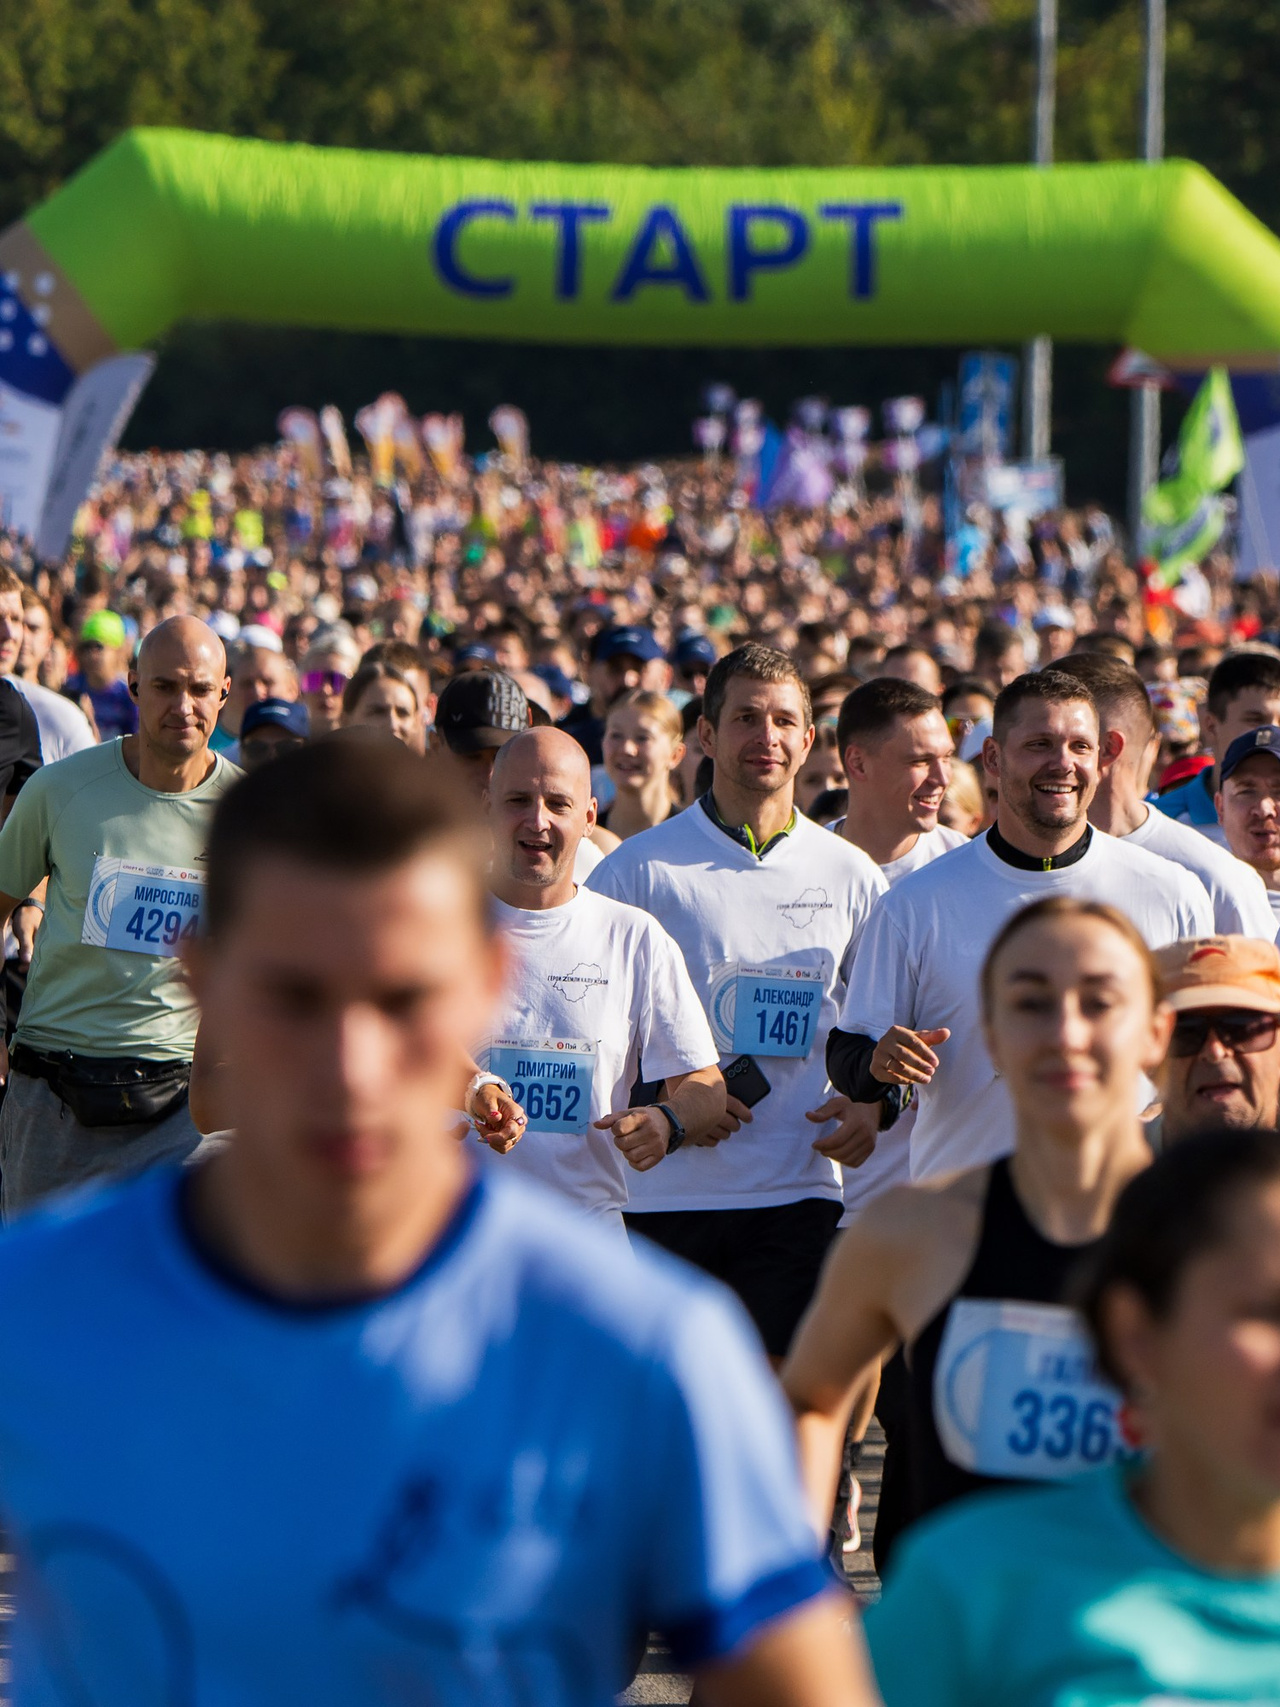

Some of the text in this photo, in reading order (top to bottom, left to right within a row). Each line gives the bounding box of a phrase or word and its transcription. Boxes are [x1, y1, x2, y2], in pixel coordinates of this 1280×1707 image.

[433, 198, 903, 303] СТАРТ
[134, 885, 200, 908] МИРОСЛАВ
[753, 987, 815, 1008] АЛЕКСАНДР
[756, 1009, 810, 1046] 1461
[515, 1060, 577, 1080] ДМИТРИЙ
